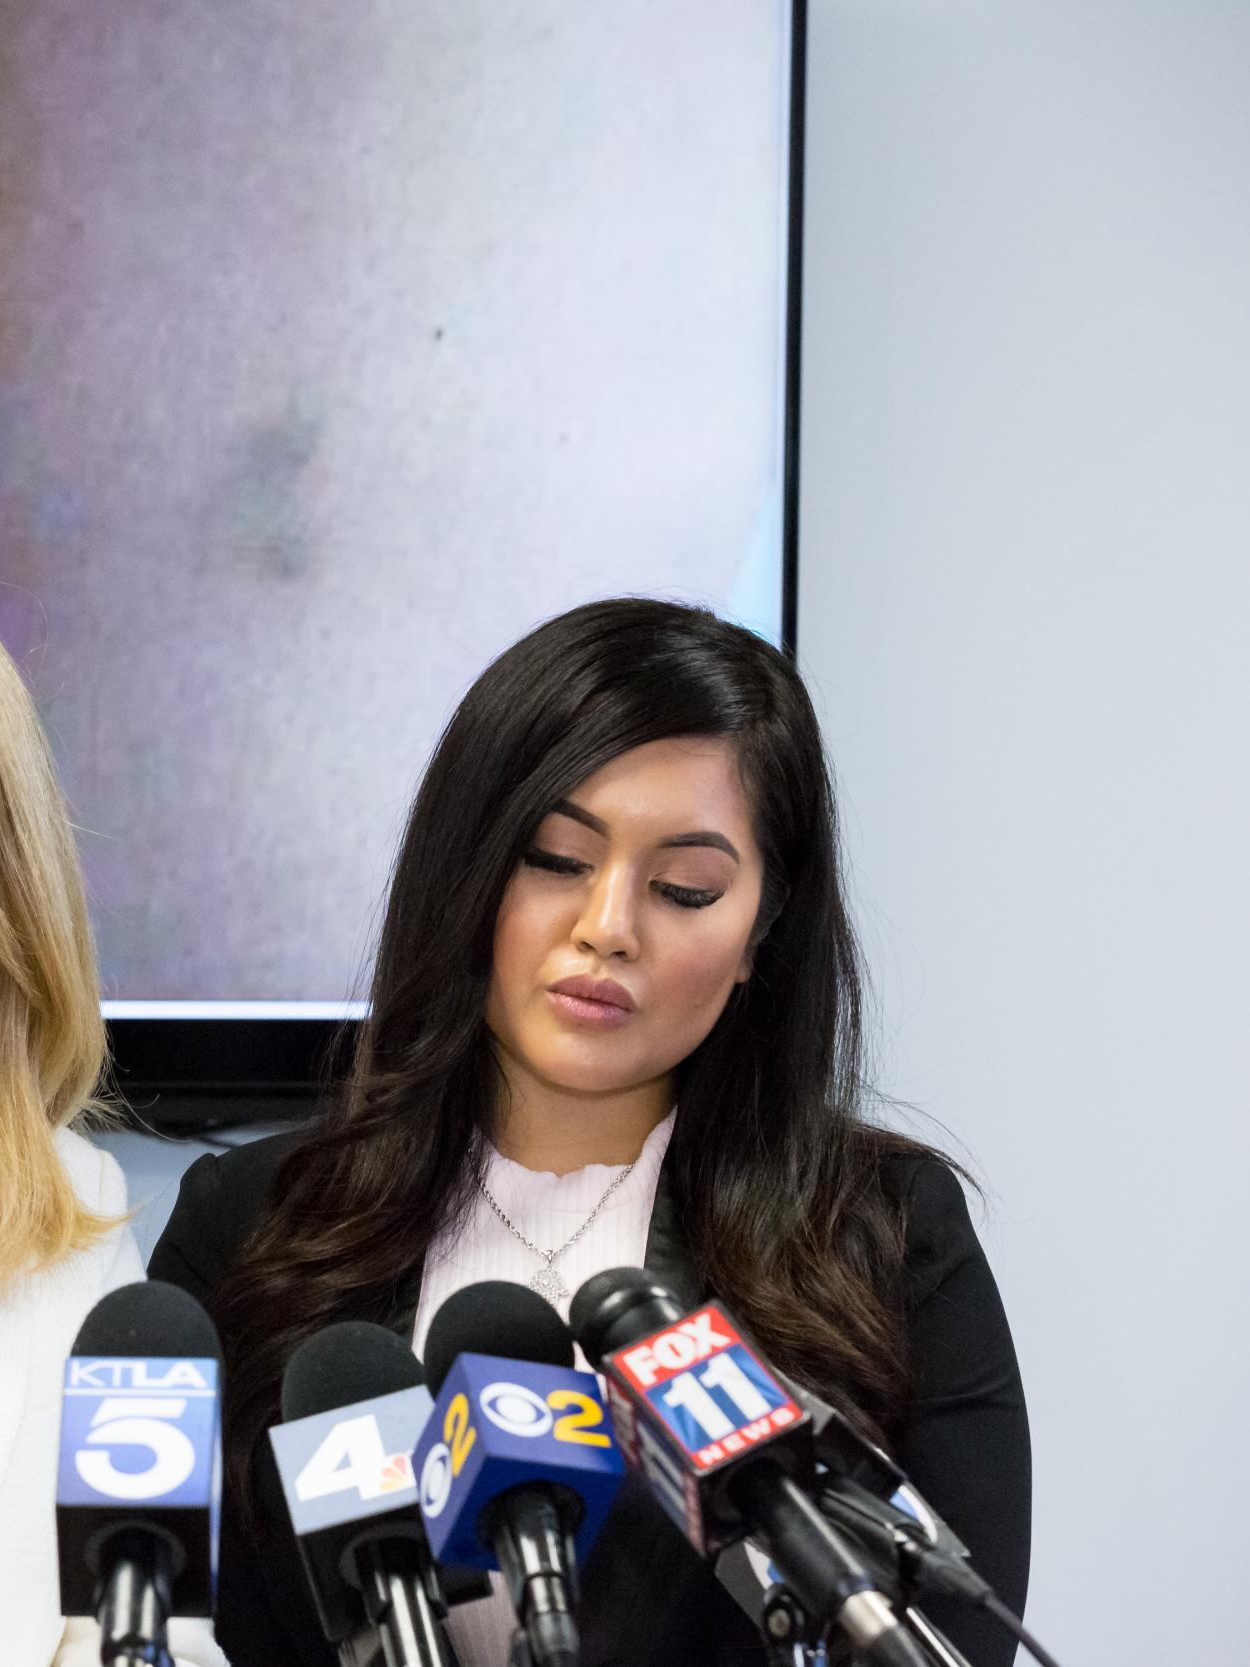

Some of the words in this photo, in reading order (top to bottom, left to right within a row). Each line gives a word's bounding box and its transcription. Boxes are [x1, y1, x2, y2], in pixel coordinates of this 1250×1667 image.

[70, 1360, 208, 1388] KTLA
[622, 1313, 732, 1387] FOX
[443, 1392, 477, 1478] 2
[546, 1389, 612, 1449] 2
[661, 1352, 773, 1441] 11
[698, 1407, 796, 1465] NEWS
[74, 1397, 196, 1501] 5
[294, 1414, 390, 1502] 4
